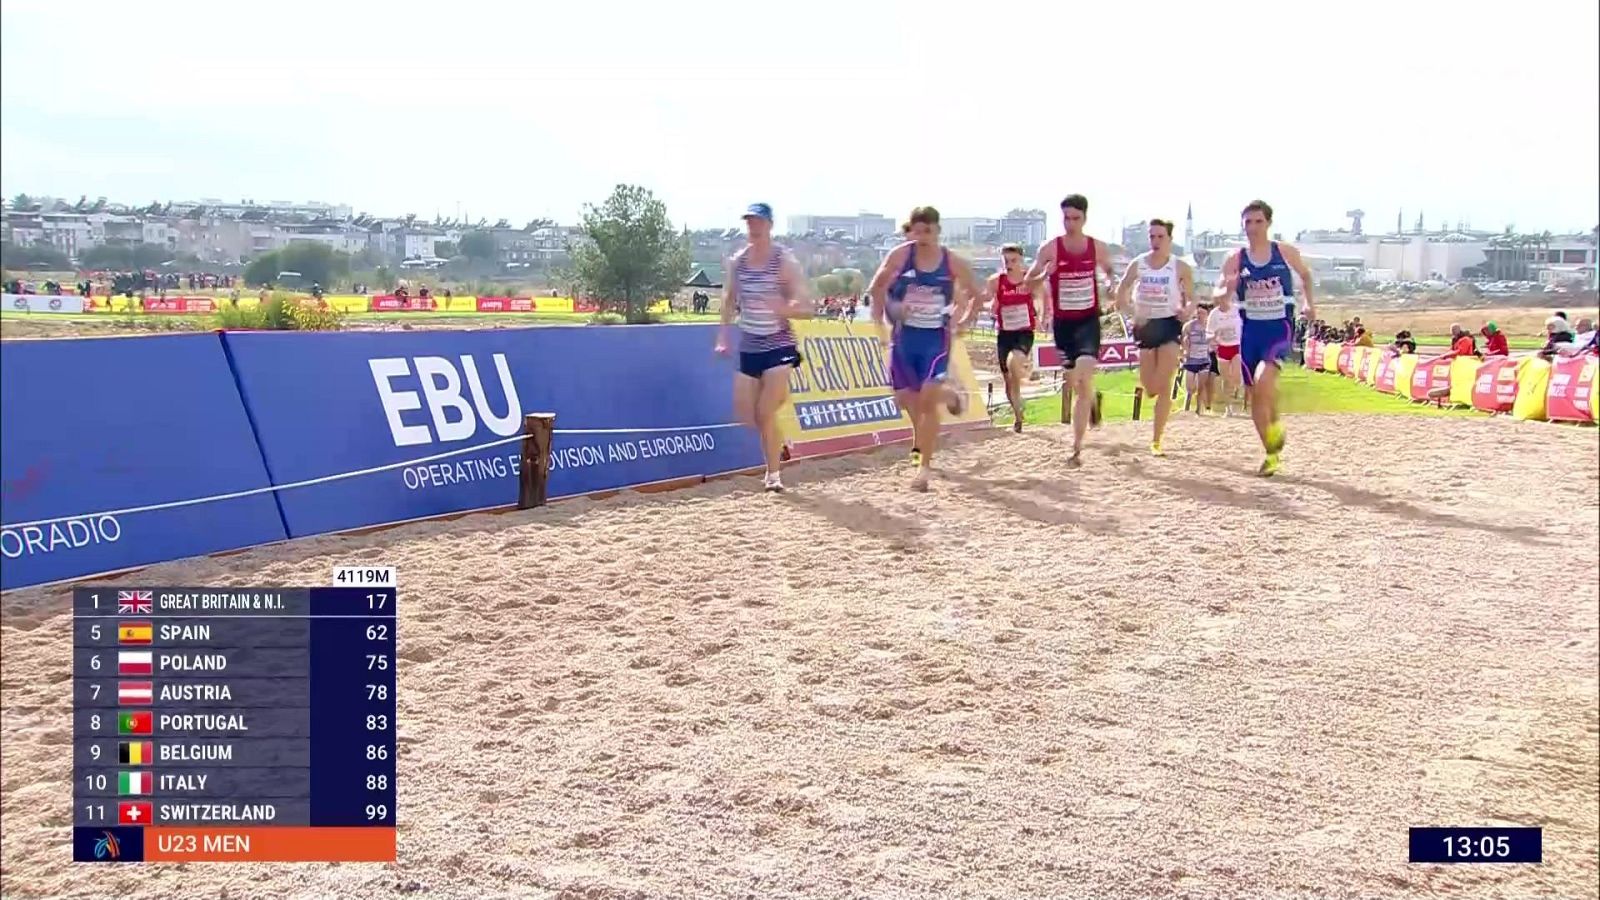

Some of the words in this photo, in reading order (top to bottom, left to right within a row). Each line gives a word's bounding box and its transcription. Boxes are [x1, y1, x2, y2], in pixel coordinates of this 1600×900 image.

[367, 353, 523, 448] EBU
[800, 398, 898, 427] SWITZERLAND
[403, 456, 506, 490] OPERATING
[508, 445, 605, 476] EOVISION
[608, 440, 638, 464] AND
[639, 432, 716, 460] EURORADIO
[1, 515, 120, 559] ORADIO
